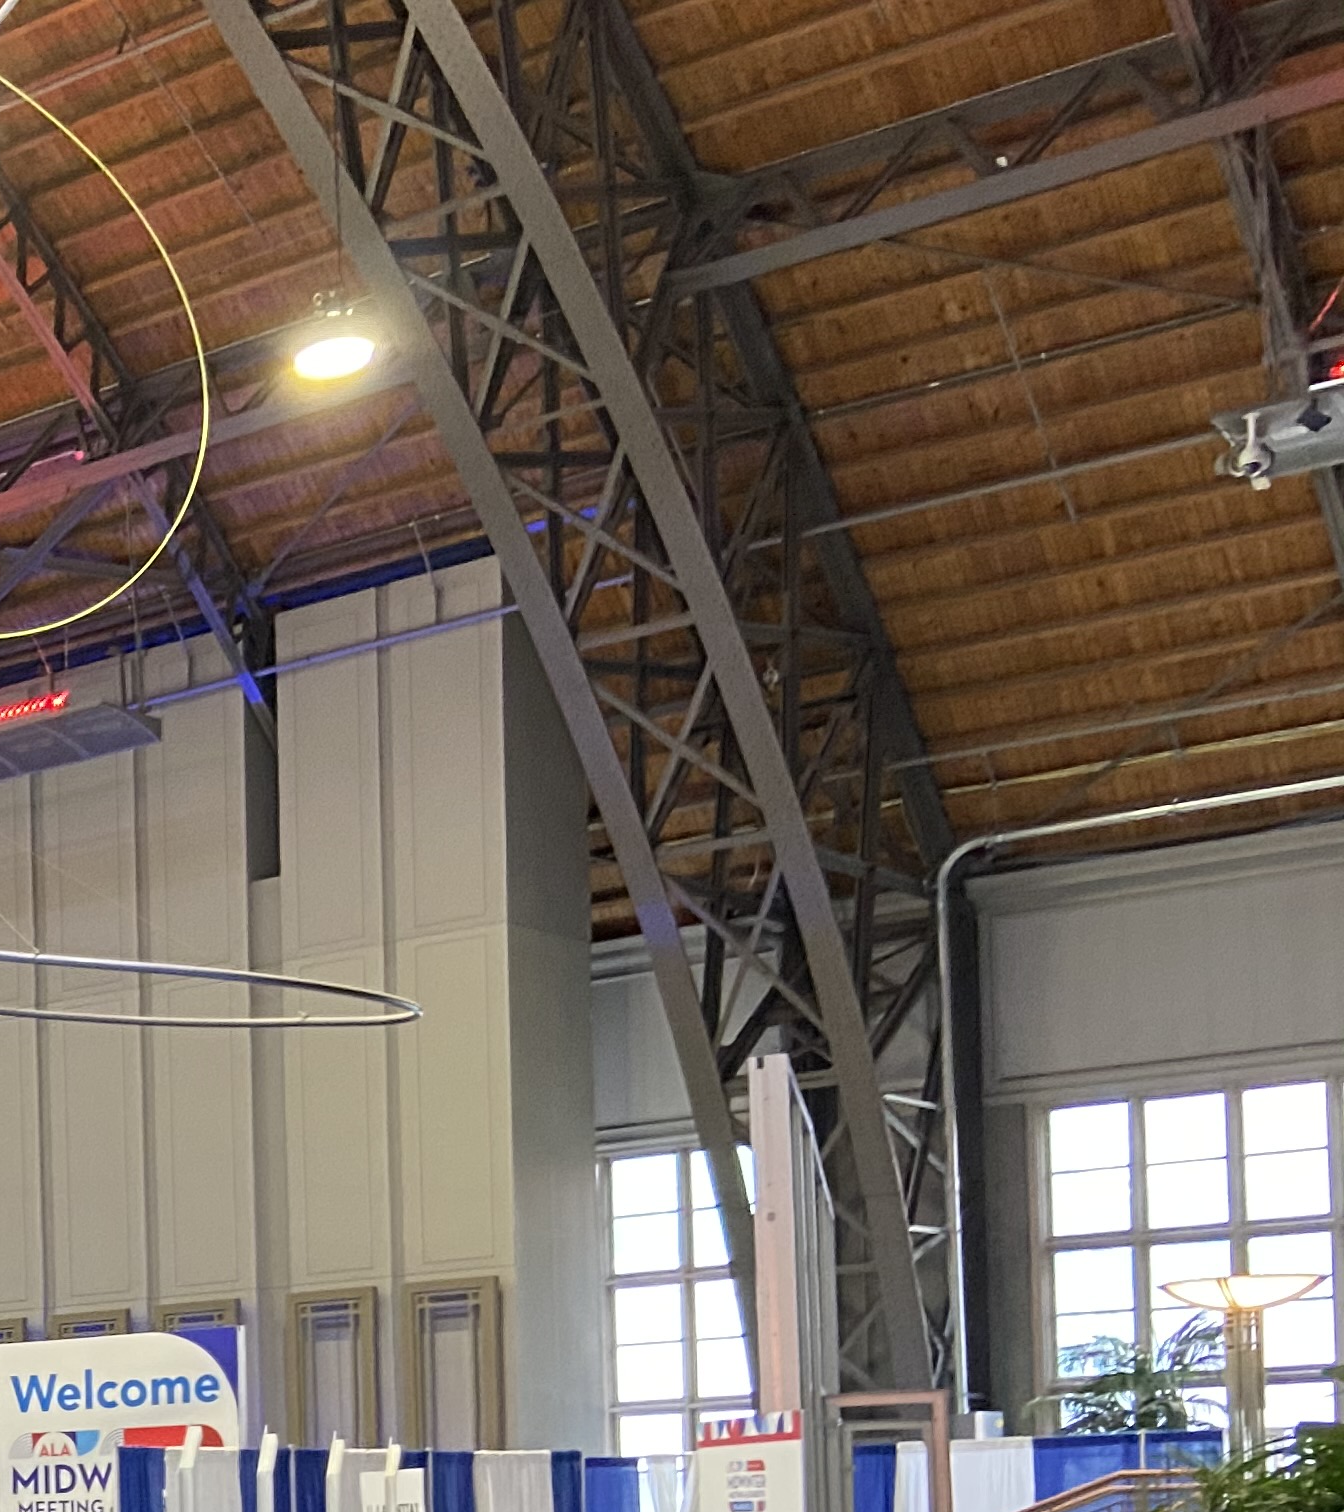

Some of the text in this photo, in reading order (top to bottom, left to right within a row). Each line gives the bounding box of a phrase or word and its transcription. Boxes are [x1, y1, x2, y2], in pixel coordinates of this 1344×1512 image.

[10, 1369, 221, 1413] Welcome
[39, 1443, 72, 1457] ALA
[11, 1463, 113, 1495] MIDW
